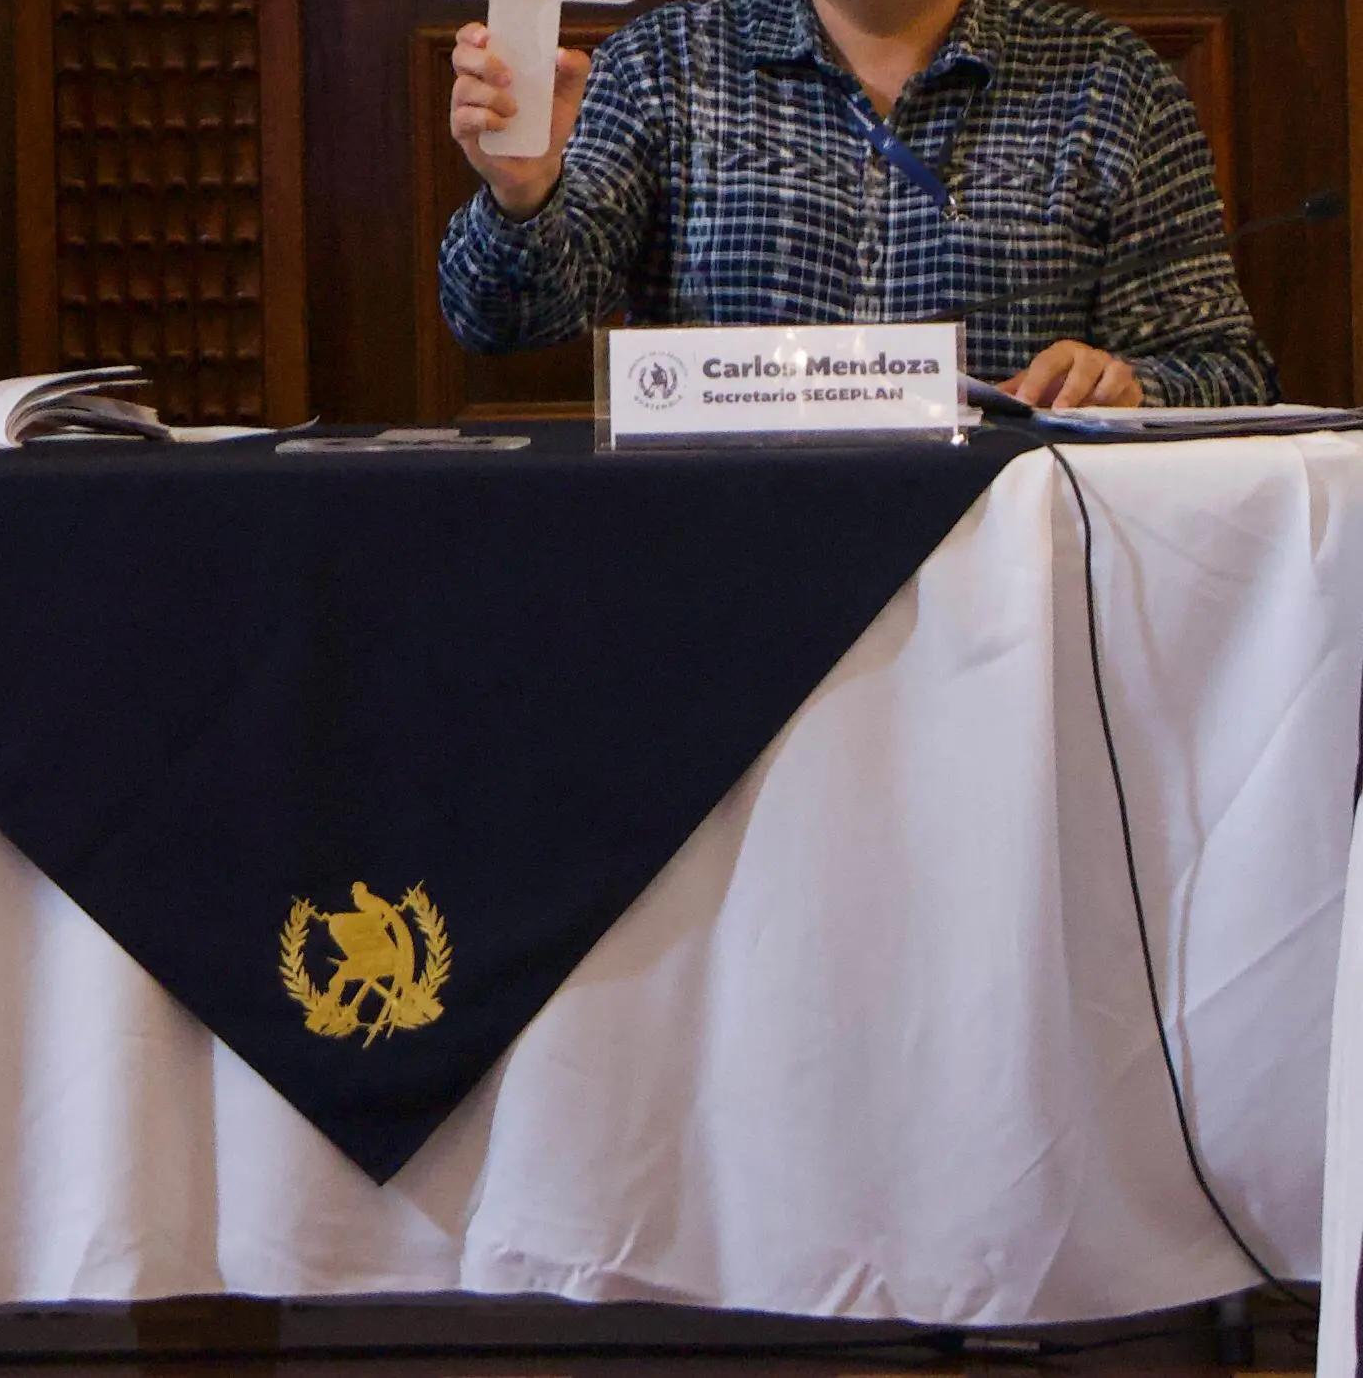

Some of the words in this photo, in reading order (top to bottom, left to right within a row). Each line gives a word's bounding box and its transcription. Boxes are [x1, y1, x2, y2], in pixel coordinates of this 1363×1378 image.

[702, 355, 797, 378] Carlos
[805, 352, 940, 377] Mendoza
[702, 389, 796, 404] Secretario
[802, 386, 904, 402] SEGEPLAN
